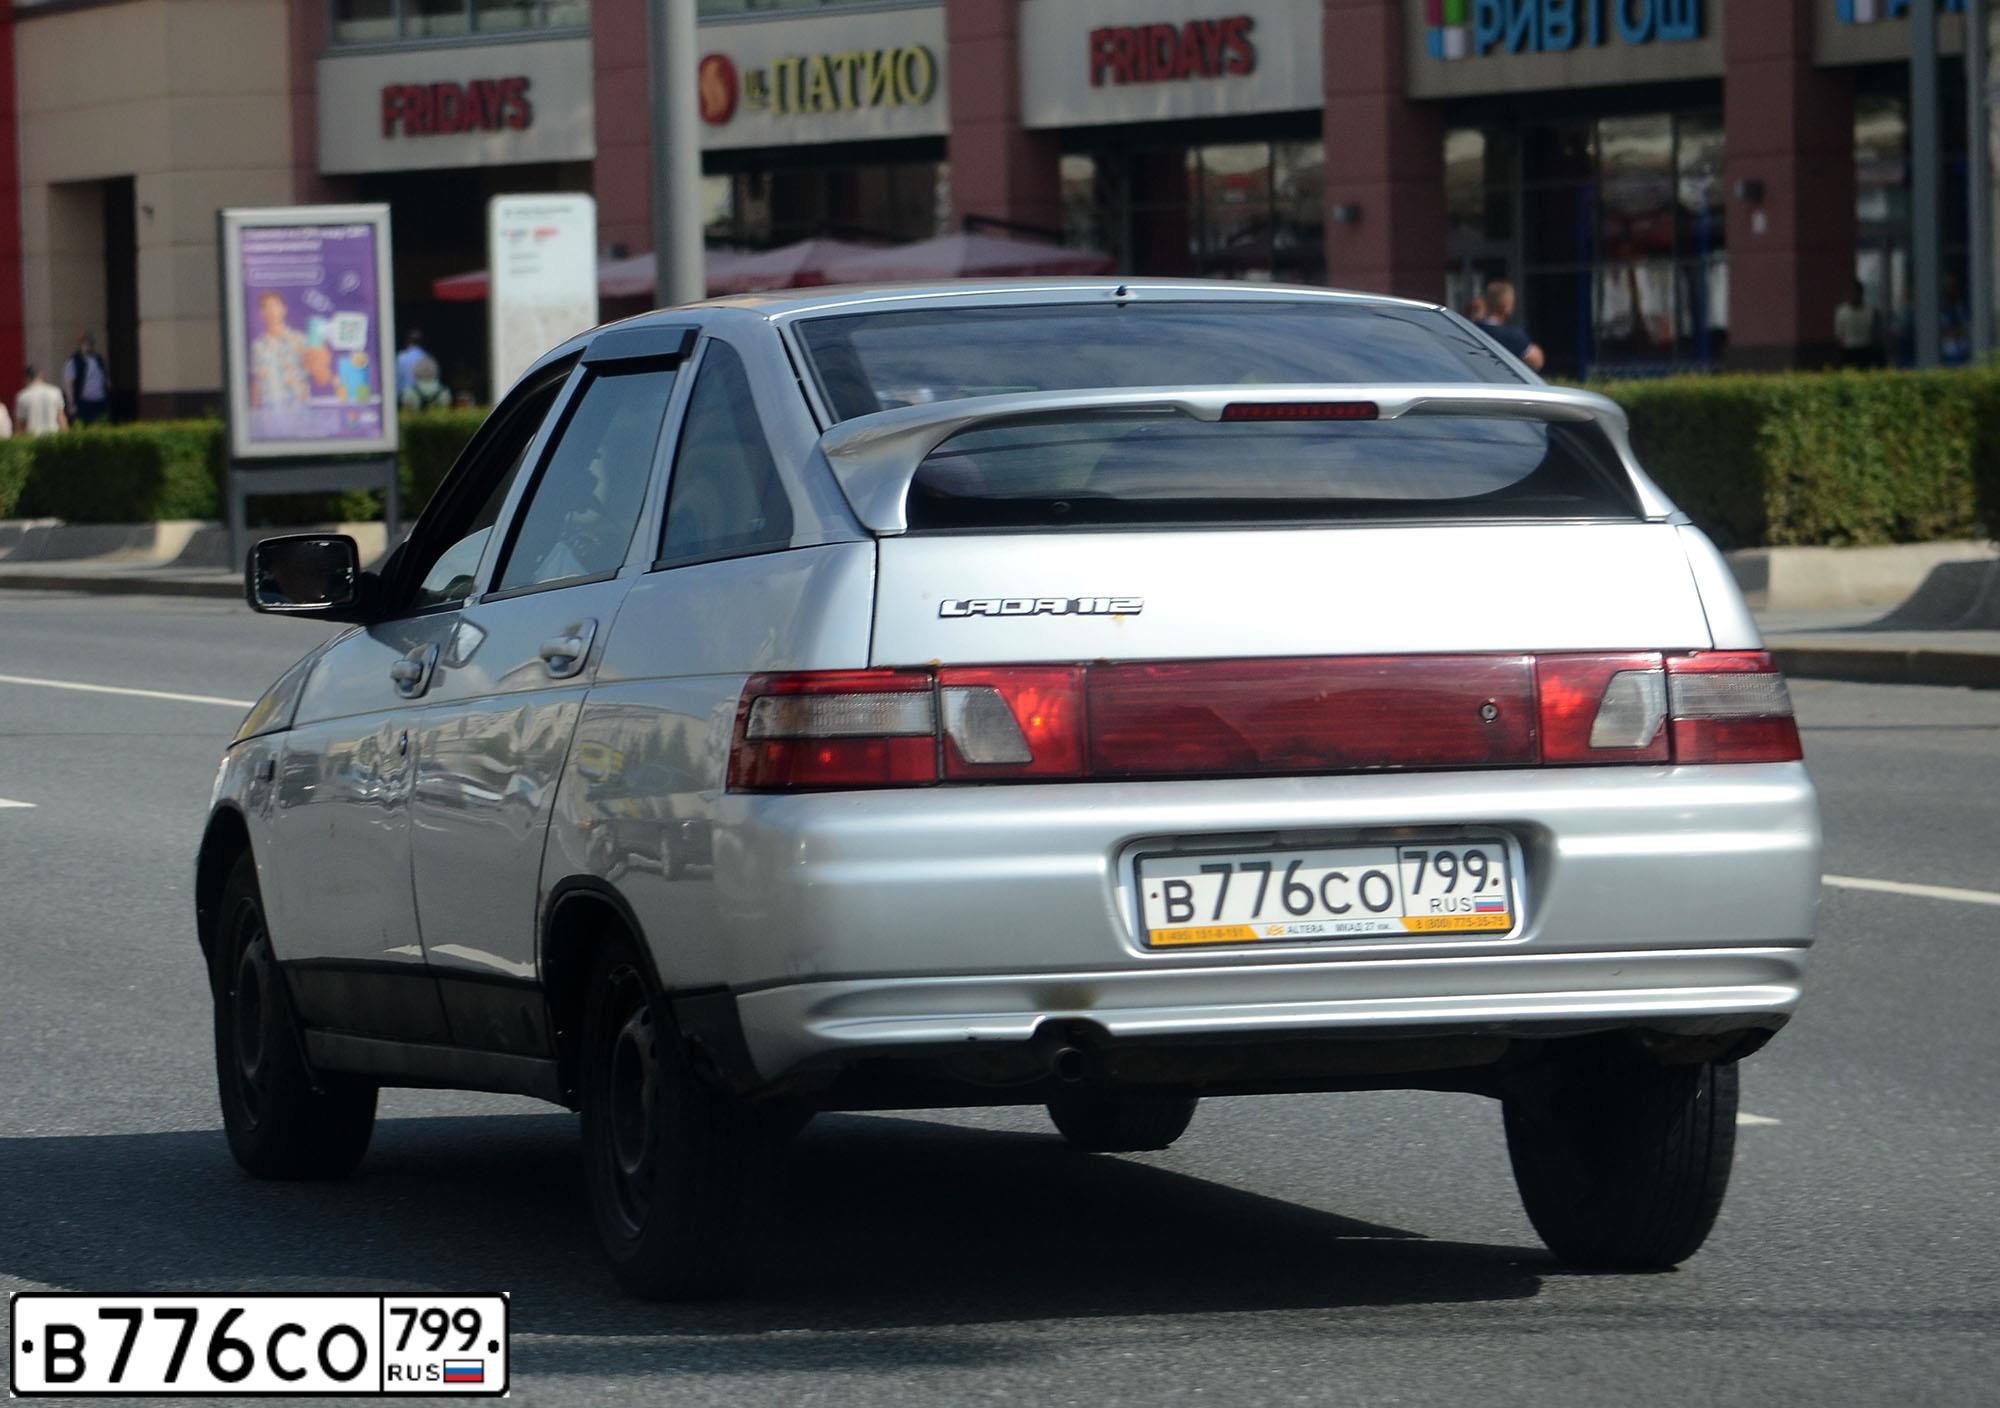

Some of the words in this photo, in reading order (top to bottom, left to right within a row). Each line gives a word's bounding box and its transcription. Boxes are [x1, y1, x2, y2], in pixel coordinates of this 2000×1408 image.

[1089, 14, 1256, 88] FRIDAYS
[770, 45, 937, 115] ПАТИО
[381, 76, 533, 139] FRIDAYS
[938, 598, 1068, 618] LADA
[1070, 596, 1145, 616] 112
[1163, 859, 1395, 923] В776СО
[1403, 849, 1488, 895] 799
[1286, 924, 1325, 935] ALTERA
[1430, 897, 1472, 912] RUS
